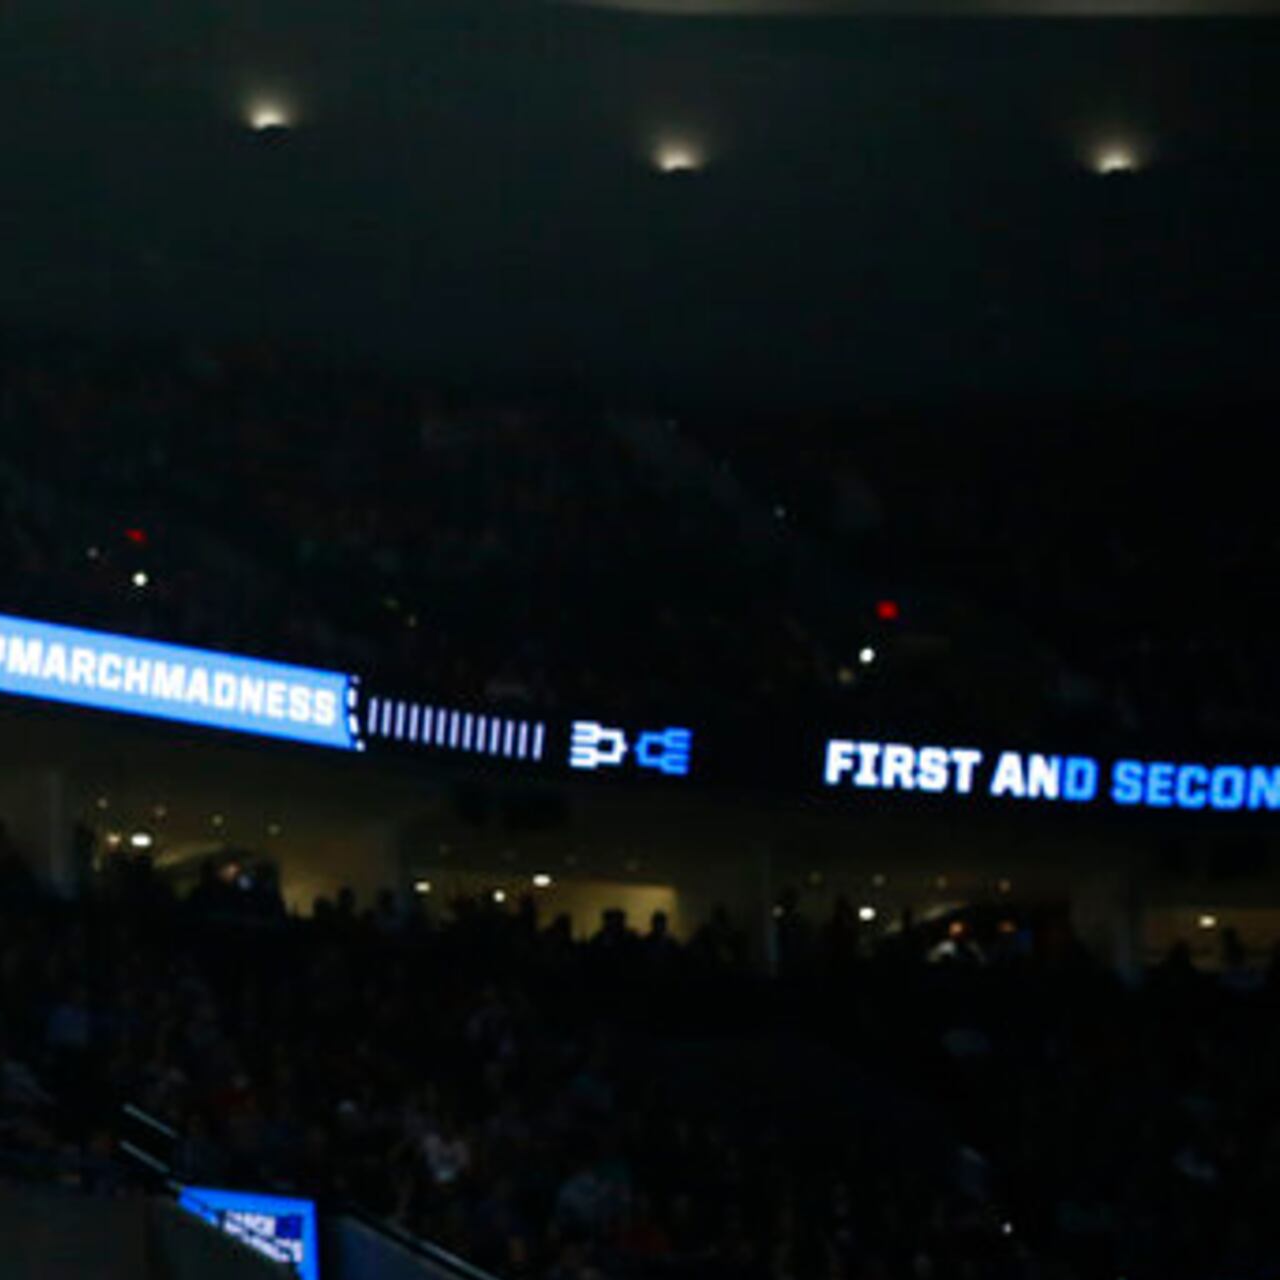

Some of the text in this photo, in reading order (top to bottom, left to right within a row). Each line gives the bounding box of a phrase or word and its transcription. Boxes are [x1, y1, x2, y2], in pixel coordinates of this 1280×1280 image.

[824, 739, 1280, 811] FIRST AND SECON
